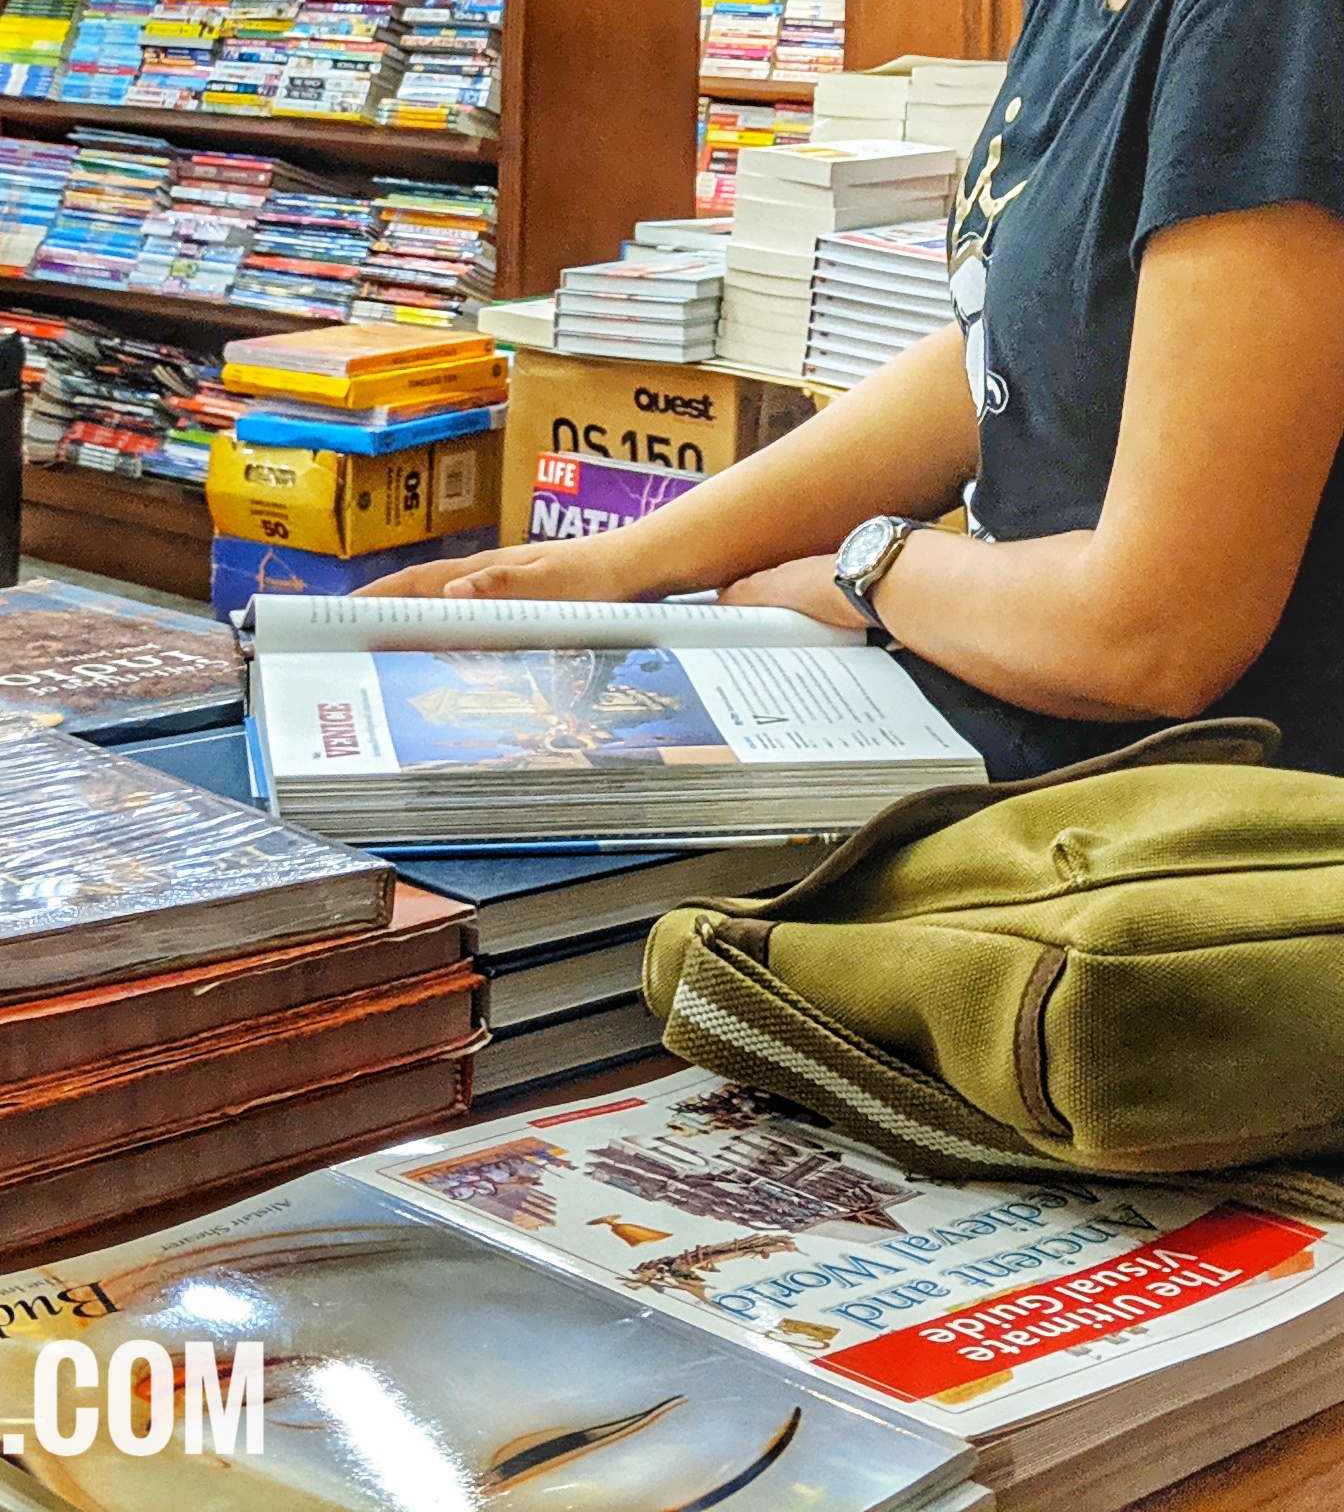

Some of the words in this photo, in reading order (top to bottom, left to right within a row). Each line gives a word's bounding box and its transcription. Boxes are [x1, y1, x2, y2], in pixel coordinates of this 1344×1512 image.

[537, 458, 576, 488] LIFE
[260, 519, 289, 539] 50
[317, 703, 361, 758] VENICE
[950, 1205, 1164, 1291] Ancient
[1063, 1248, 1197, 1303] Visual
[1142, 1254, 1245, 1300] The
[713, 1243, 904, 1322] World
[834, 1268, 942, 1333] and
[919, 1284, 1070, 1346] Guide
[957, 1291, 1162, 1364] Ultimate
